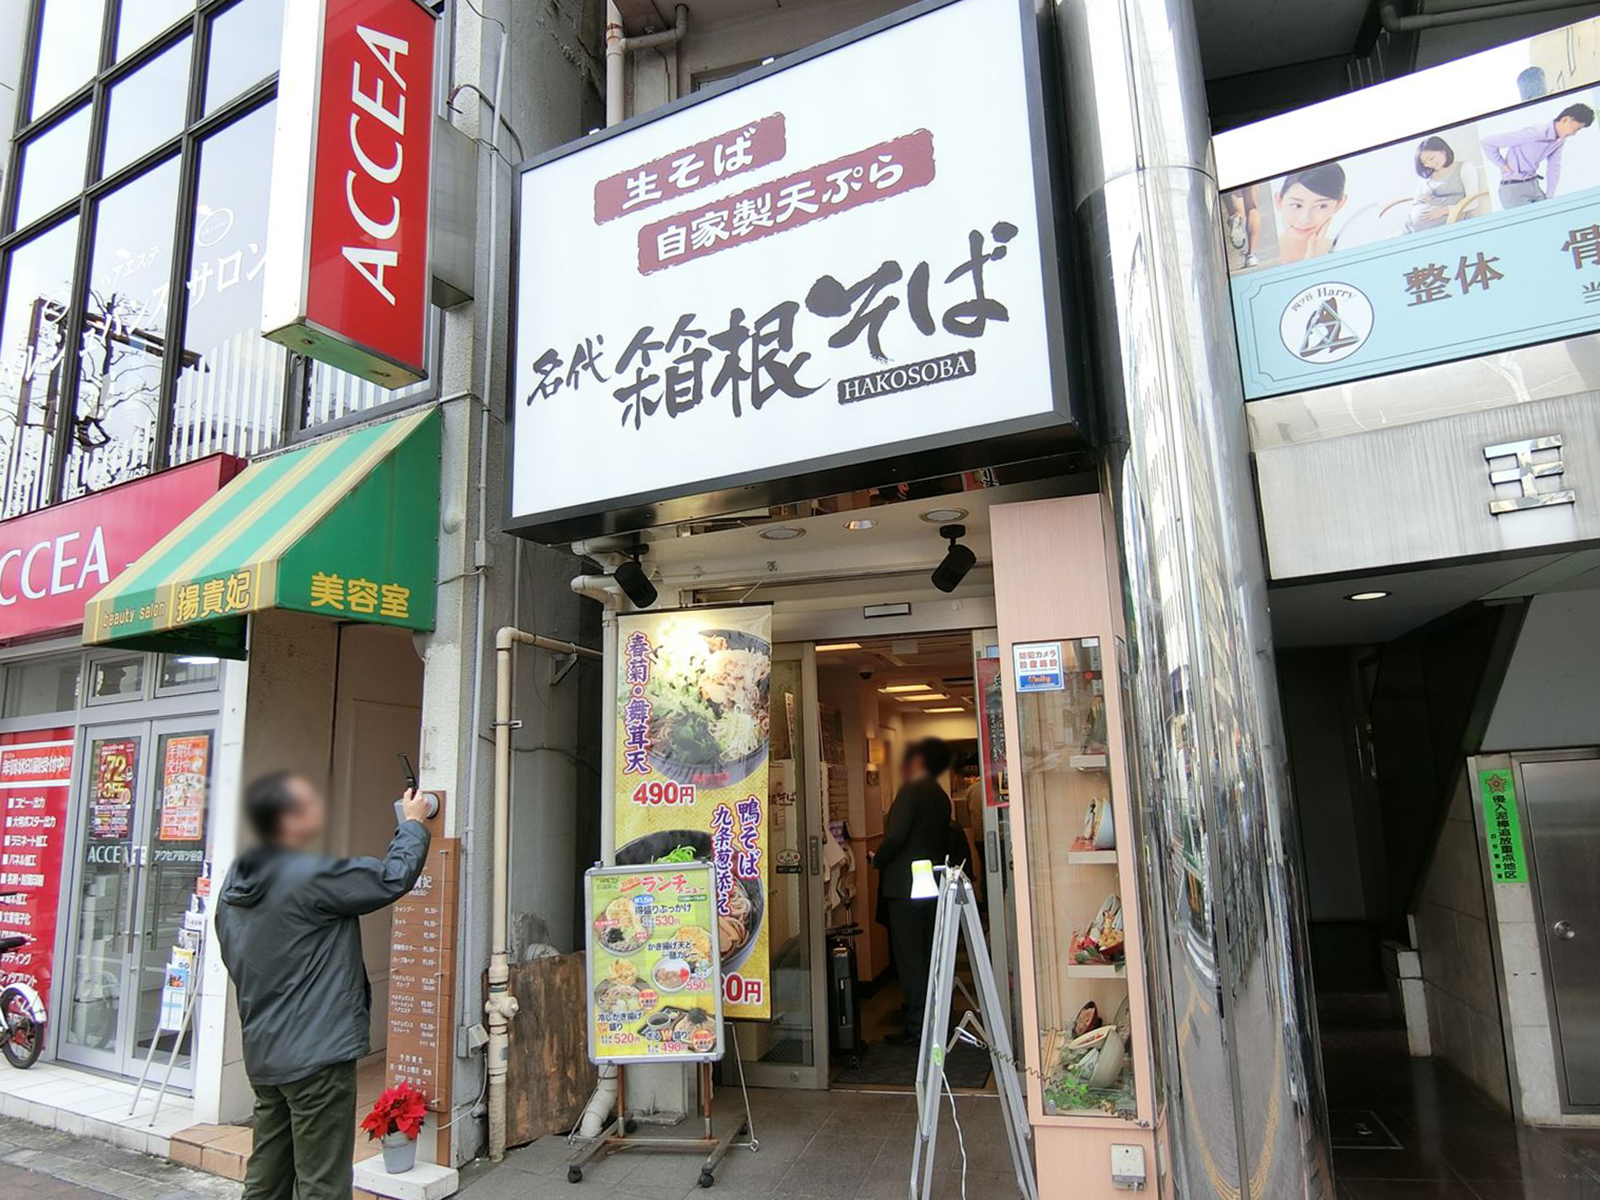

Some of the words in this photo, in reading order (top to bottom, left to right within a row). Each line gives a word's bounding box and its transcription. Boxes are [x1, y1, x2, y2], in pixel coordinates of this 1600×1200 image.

[342, 24, 409, 306] ACCEA
[622, 131, 755, 210] 生そば
[655, 158, 904, 262] 自家製天ぷら
[1402, 251, 1504, 307] 整体
[526, 335, 611, 407] 名代
[613, 221, 1019, 431] 箱根そば
[843, 357, 972, 400] HAKOSOBA
[102, 607, 135, 629] beauty
[139, 601, 166, 621] salon
[175, 570, 251, 624] 揚貴妃
[310, 571, 411, 619] 美容室
[623, 632, 652, 774] 春菊・舞茸天
[632, 782, 695, 806] 490円
[736, 797, 762, 878] 鴨そば
[642, 874, 687, 893] ランチ
